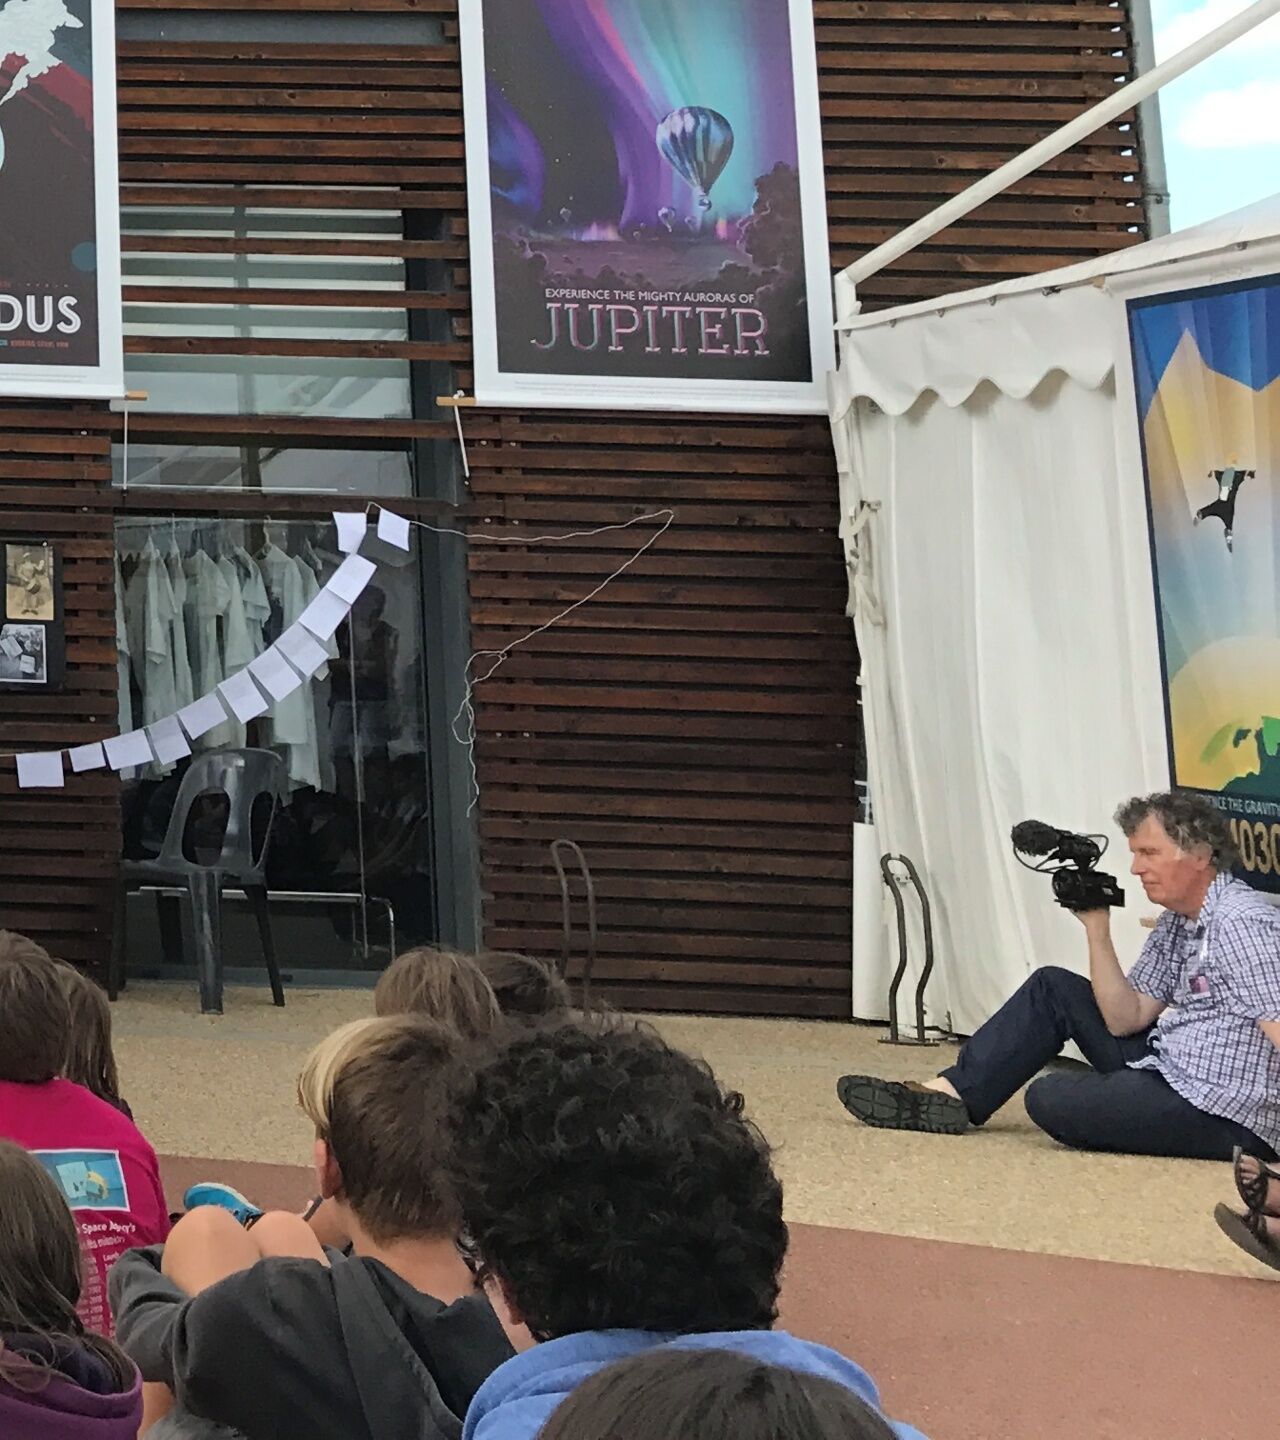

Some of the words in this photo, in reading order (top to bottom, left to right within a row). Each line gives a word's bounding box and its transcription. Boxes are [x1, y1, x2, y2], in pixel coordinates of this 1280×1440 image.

[545, 288, 611, 300] EXPERIENCE
[613, 291, 636, 301] THE
[639, 291, 681, 302] MIGHTY
[683, 292, 736, 303] AURORAS
[739, 293, 755, 304] OF
[530, 303, 770, 355] JUPITER
[1227, 797, 1243, 812] THE
[82, 1224, 107, 1234] Space
